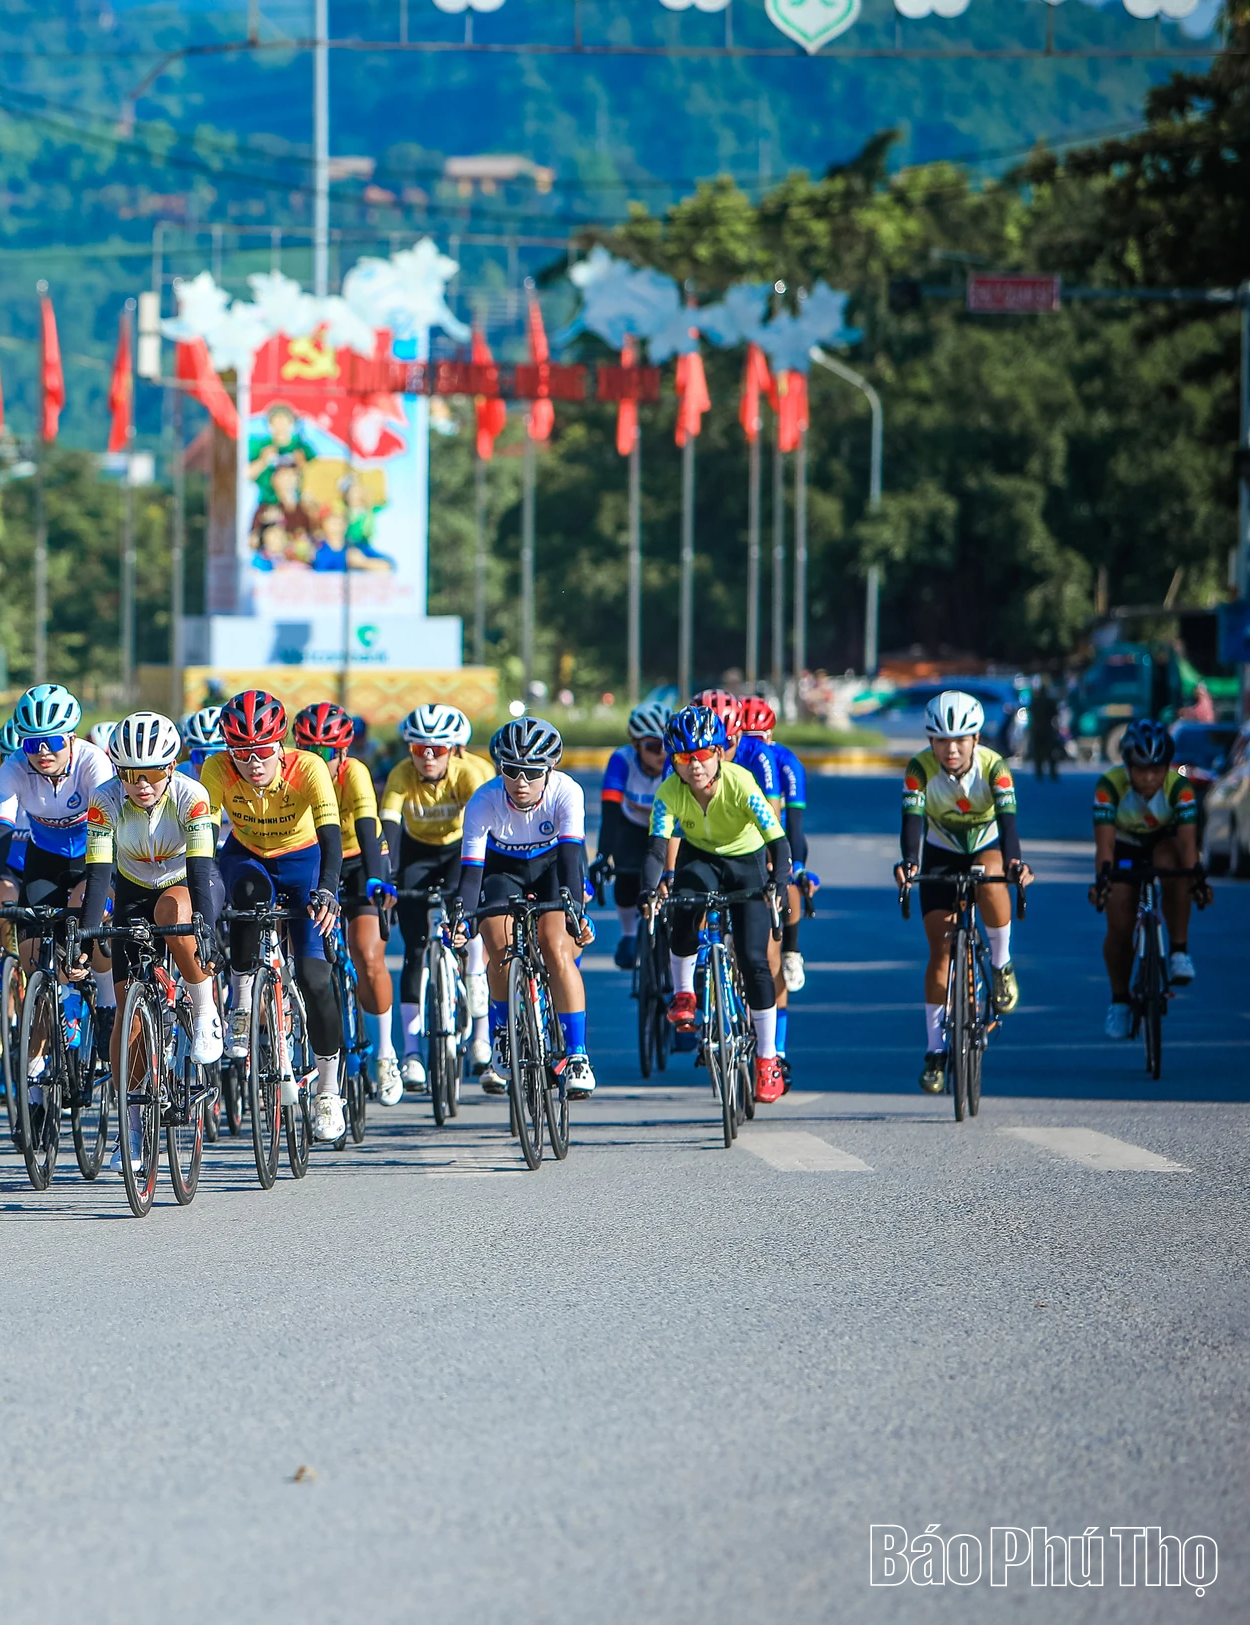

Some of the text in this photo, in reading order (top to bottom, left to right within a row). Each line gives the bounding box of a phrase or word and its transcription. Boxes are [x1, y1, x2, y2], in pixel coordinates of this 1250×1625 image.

[232, 811, 296, 825] HO CHI MINH CITY
[516, 922, 524, 956] GIANT
